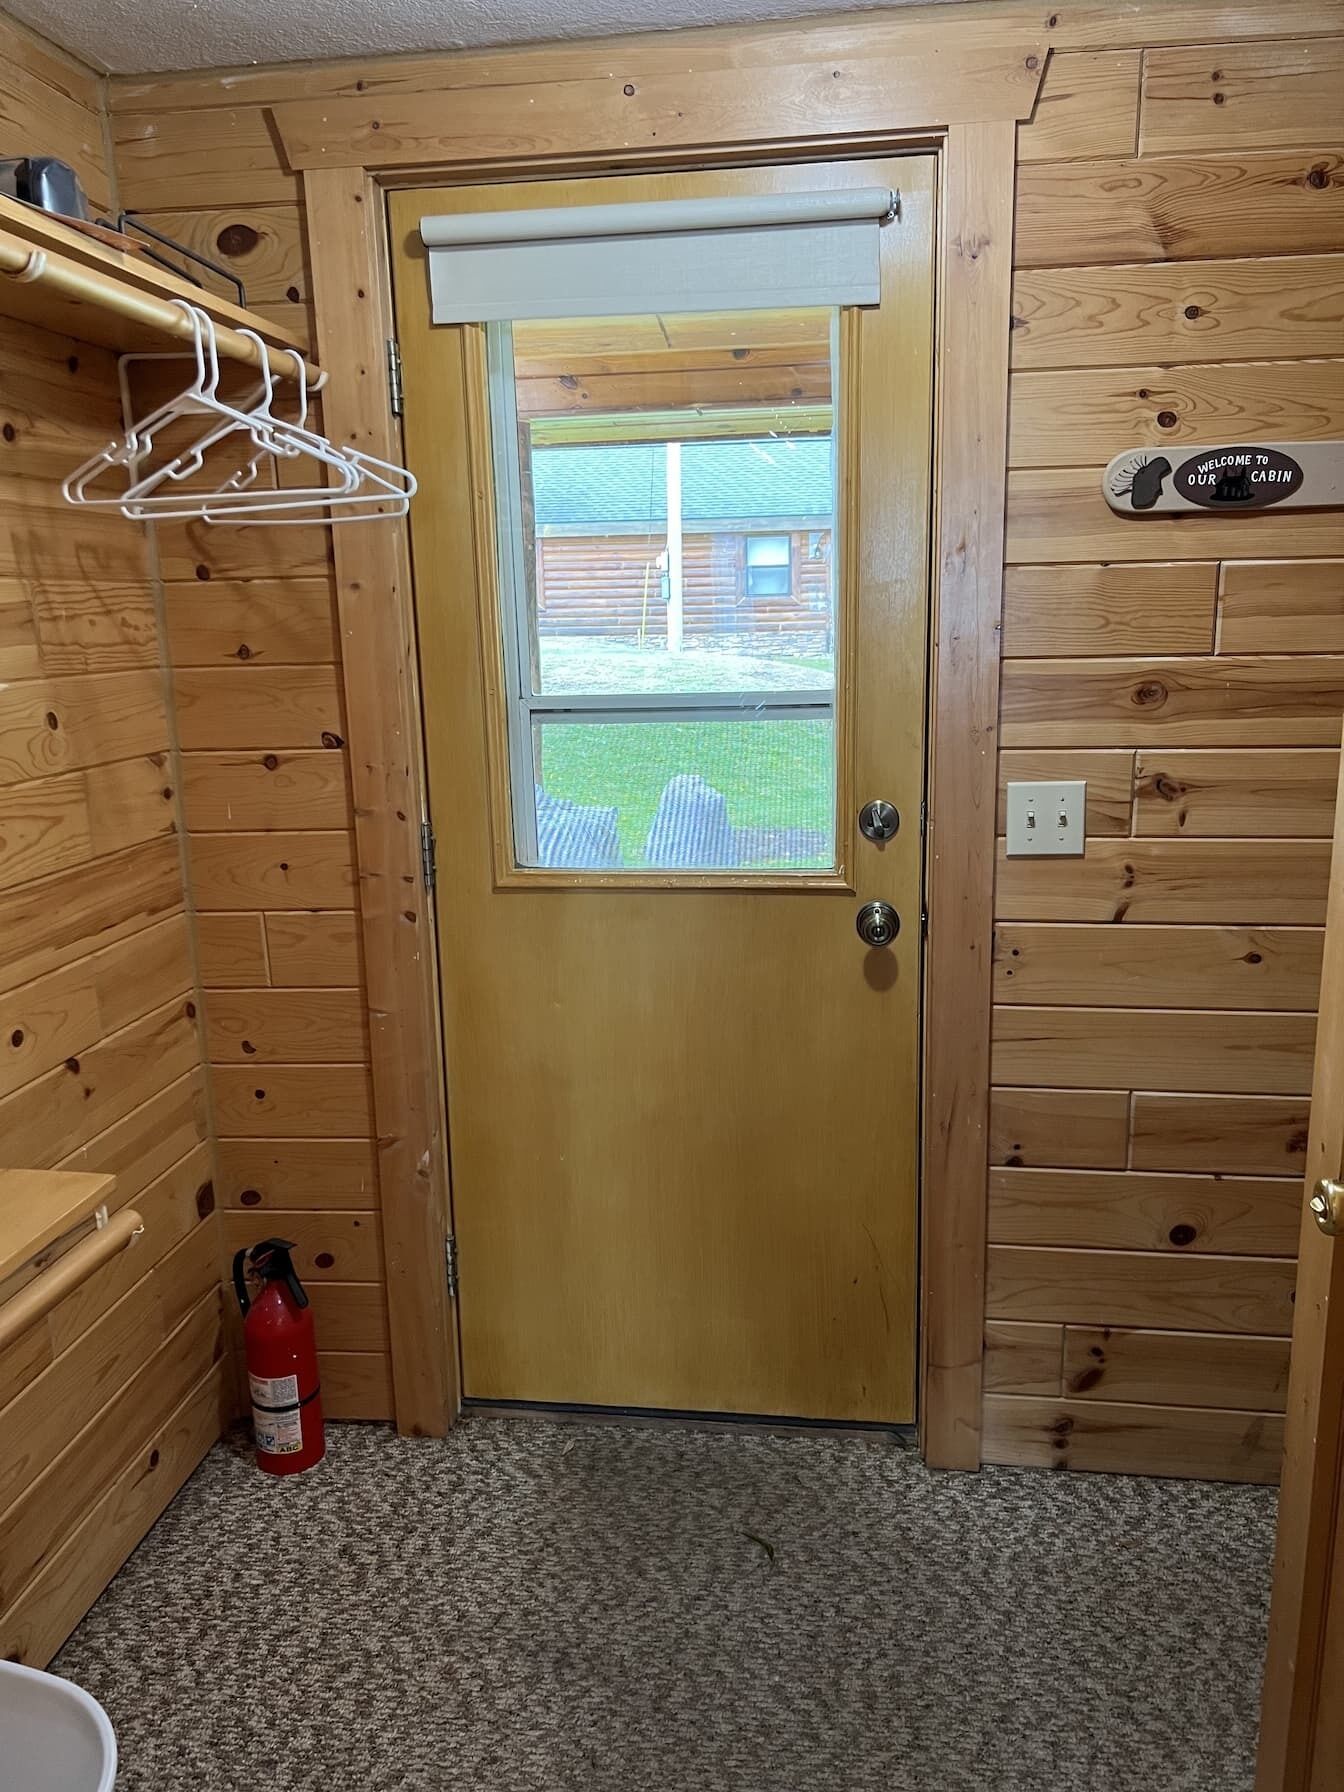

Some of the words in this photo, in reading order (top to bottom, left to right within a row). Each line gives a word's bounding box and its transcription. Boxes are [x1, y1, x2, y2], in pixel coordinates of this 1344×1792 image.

[1197, 454, 1252, 474] WELCOME
[1256, 454, 1269, 465] TO
[1188, 474, 1216, 485] OUR
[1251, 470, 1292, 482] CABIN
